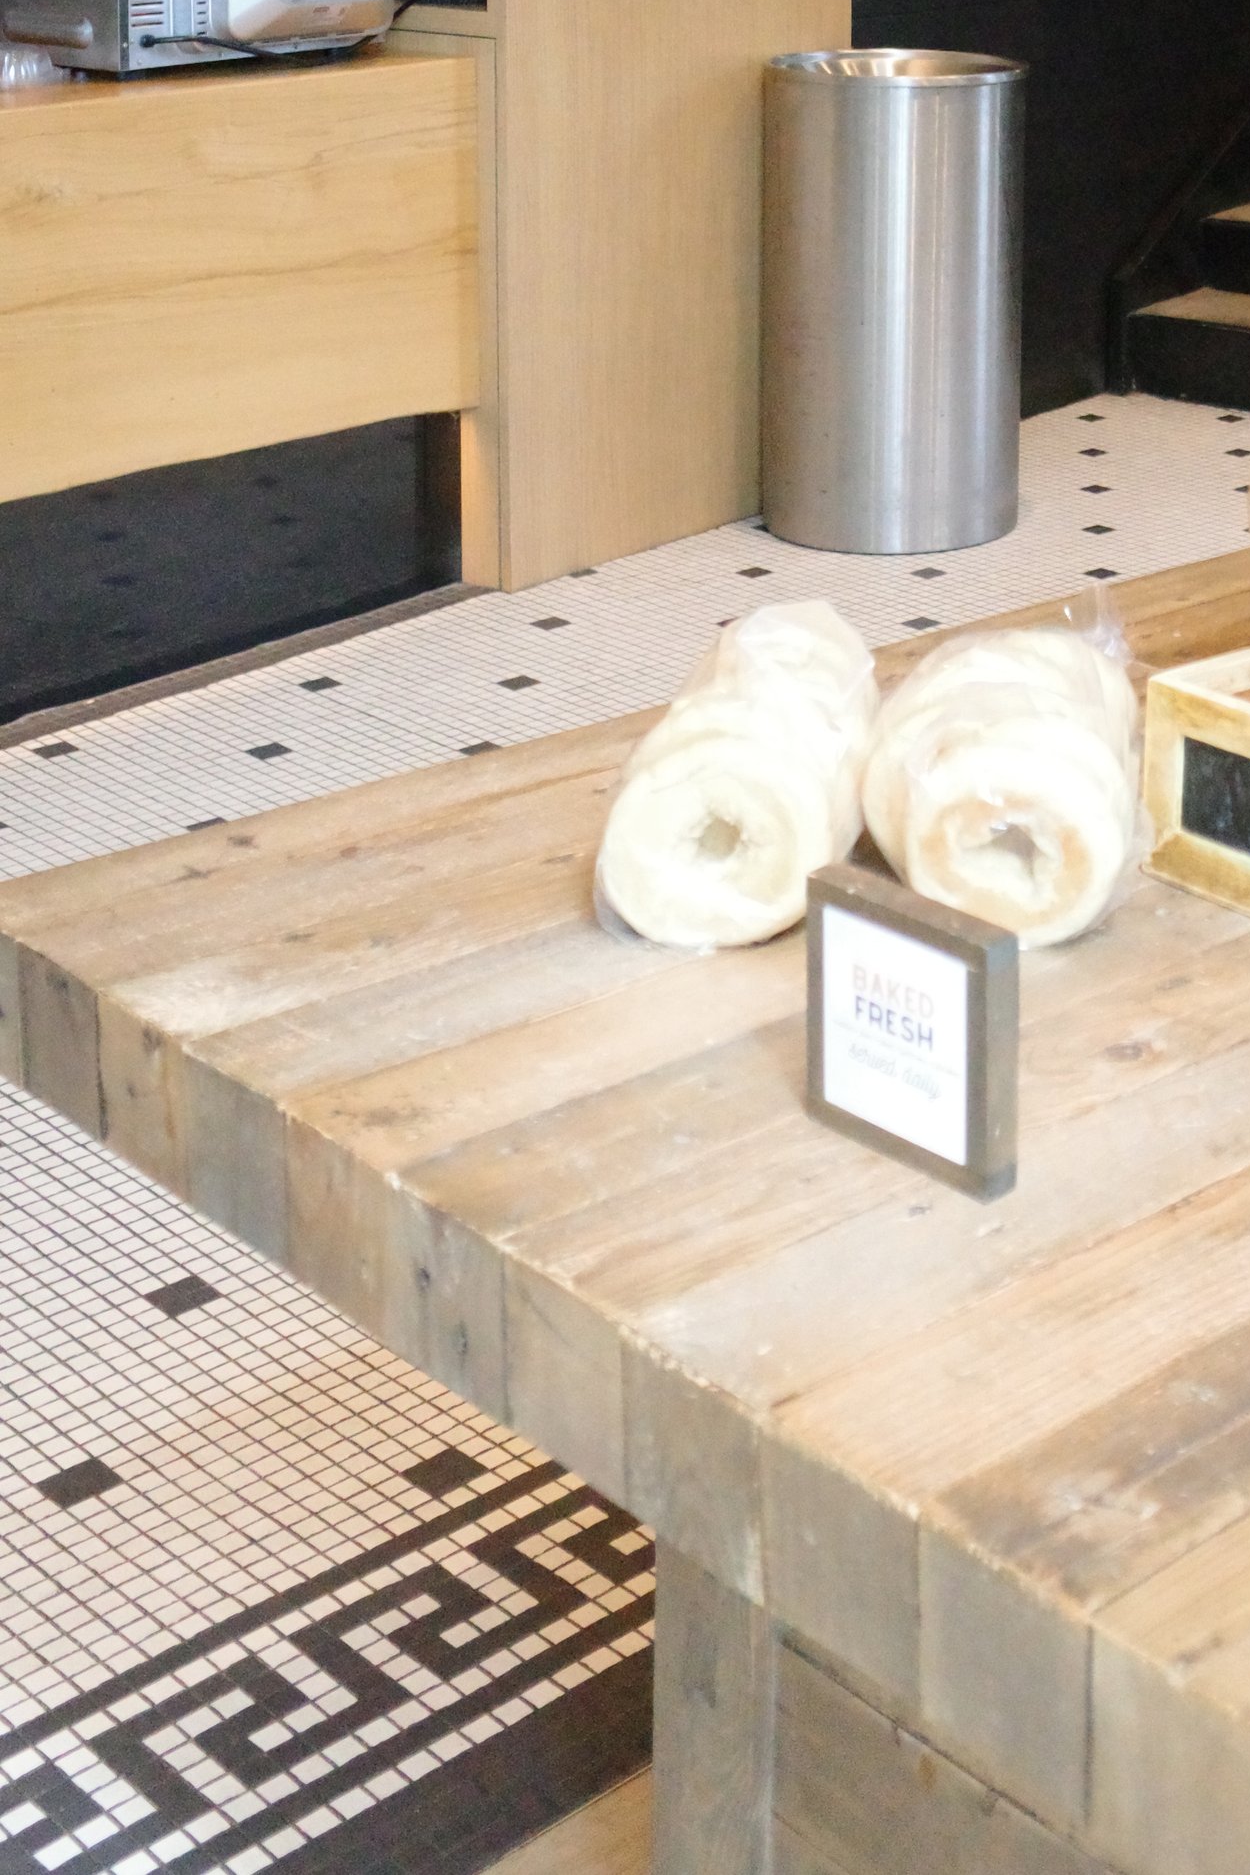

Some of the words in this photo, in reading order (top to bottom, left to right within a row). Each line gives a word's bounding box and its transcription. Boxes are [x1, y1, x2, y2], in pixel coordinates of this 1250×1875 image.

[853, 963, 934, 1019] BAKED
[855, 995, 933, 1052] FRESH
[902, 1067, 941, 1102] daily
